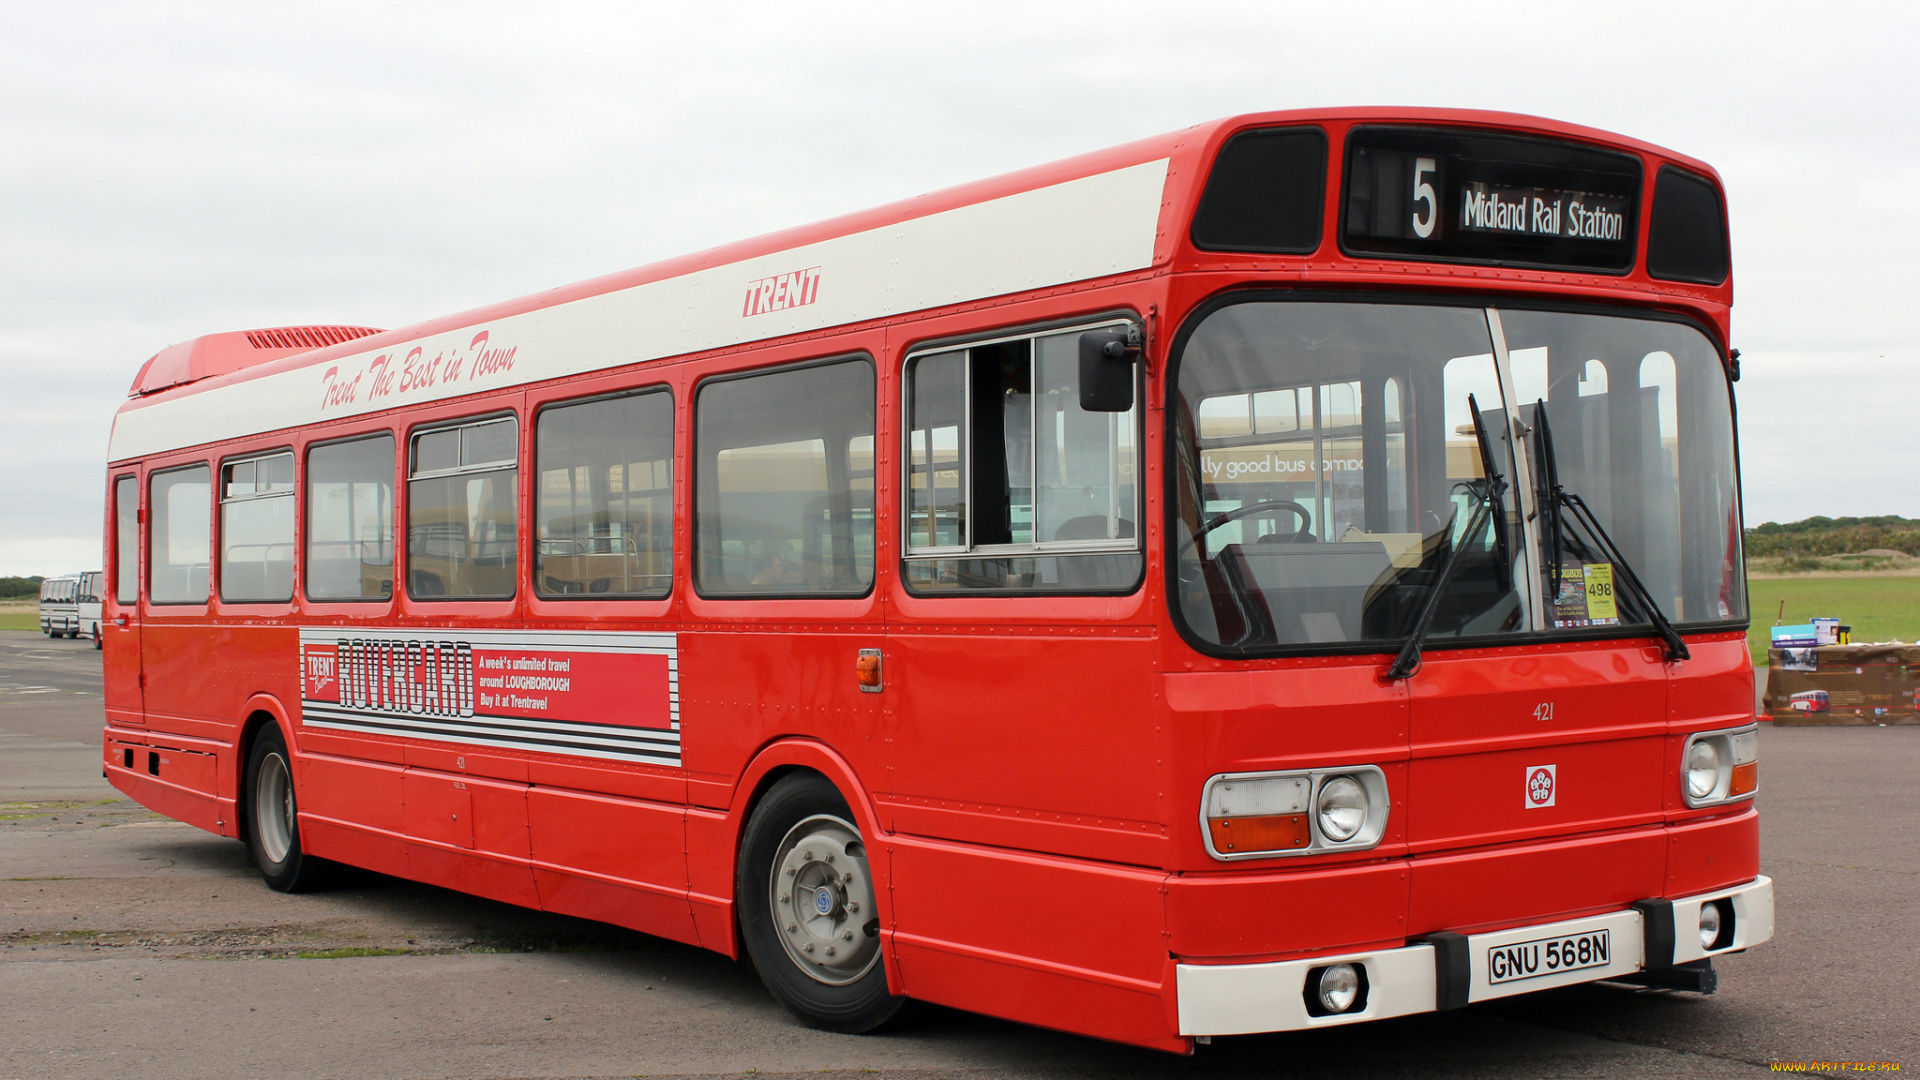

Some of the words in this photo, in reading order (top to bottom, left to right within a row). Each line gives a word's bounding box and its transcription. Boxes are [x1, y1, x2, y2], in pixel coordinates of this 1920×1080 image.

[1412, 157, 1438, 239] 5
[1464, 189, 1527, 232] Midland
[1532, 197, 1561, 235] Rail
[1567, 201, 1623, 240] Station
[744, 266, 821, 317] TRENT
[321, 366, 364, 410] Trent
[368, 353, 395, 401] The
[399, 346, 444, 393] Best
[442, 349, 463, 383] in
[469, 330, 518, 381] Town
[1226, 454, 1270, 479] good
[1275, 455, 1306, 473] bus
[1588, 583, 1611, 596] 498
[307, 656, 335, 676] TRENT
[479, 655, 485, 669] A
[485, 656, 511, 670] week's
[513, 657, 546, 671] unlimited
[548, 658, 570, 672] travel
[337, 638, 474, 718] ROVERCARD
[479, 675, 504, 688] around
[505, 675, 570, 692] LOUGHBOROUGH
[480, 692, 494, 708] Buy
[495, 693, 501, 706] it
[502, 695, 509, 707] at
[510, 694, 548, 710] Trentravel
[1532, 702, 1554, 721] 421
[1491, 944, 1539, 979] GNU
[1546, 933, 1608, 970] 568N
